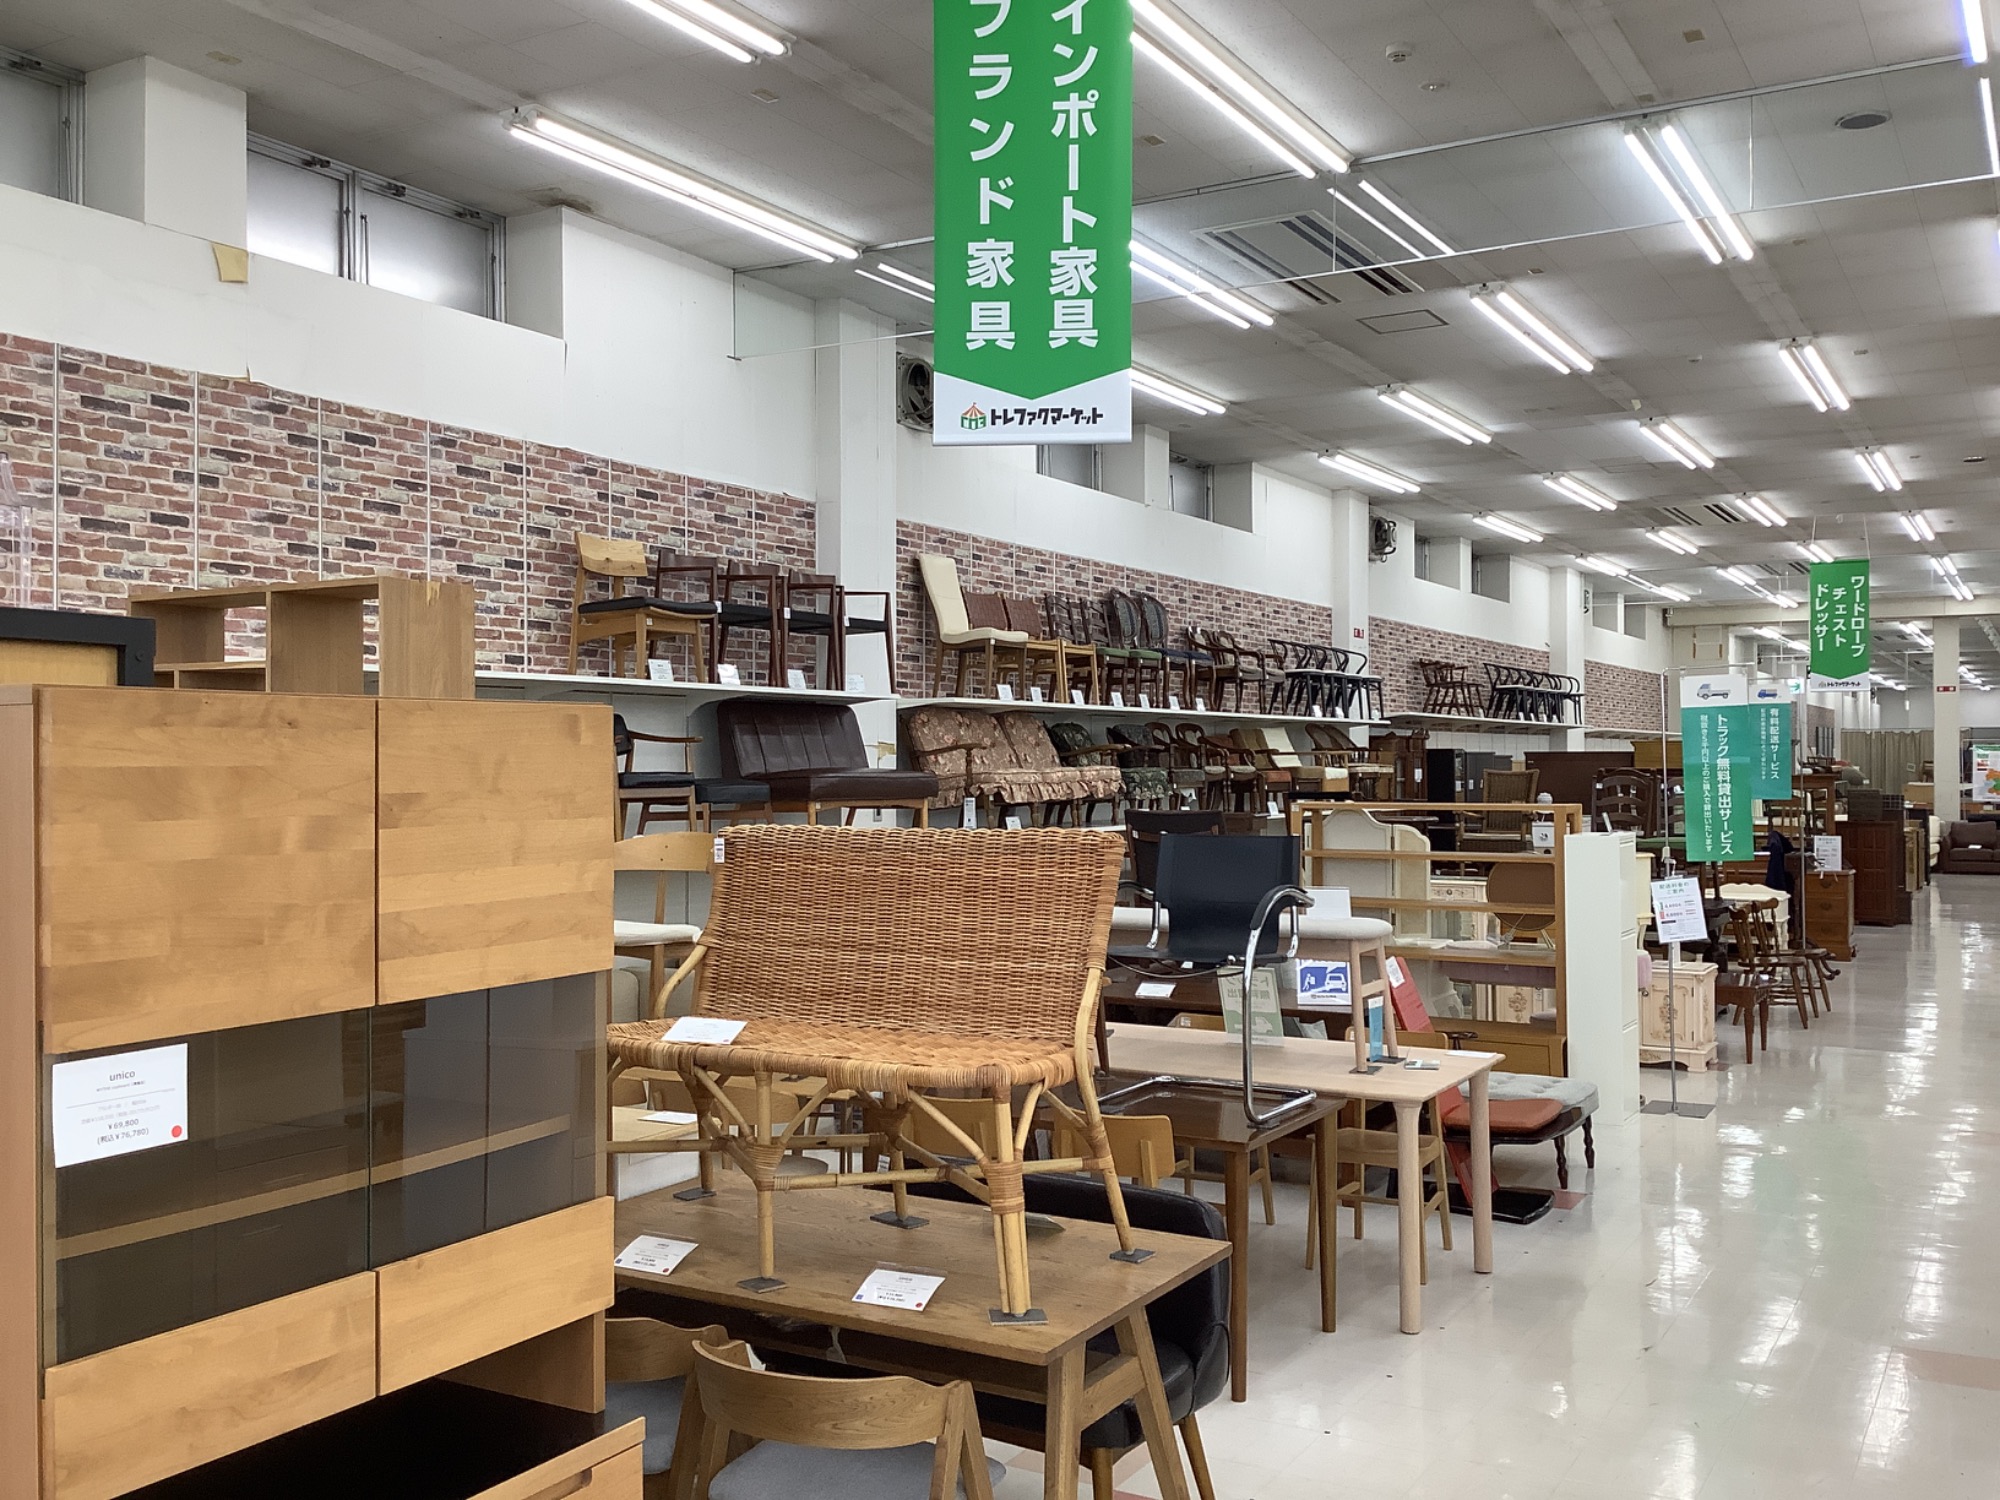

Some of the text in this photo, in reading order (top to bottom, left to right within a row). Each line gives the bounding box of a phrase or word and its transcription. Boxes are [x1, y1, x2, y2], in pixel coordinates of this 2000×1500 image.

[1048, 0, 1099, 349] インポート家具
[990, 407, 1104, 426] トレファクマーケット
[1814, 583, 1829, 651] ドレッサー
[1832, 587, 1847, 647] チェスト
[1851, 575, 1866, 657] ワードローブ
[1717, 714, 1734, 855] トラック無料貸出サービス
[109, 1070, 136, 1082] unico
